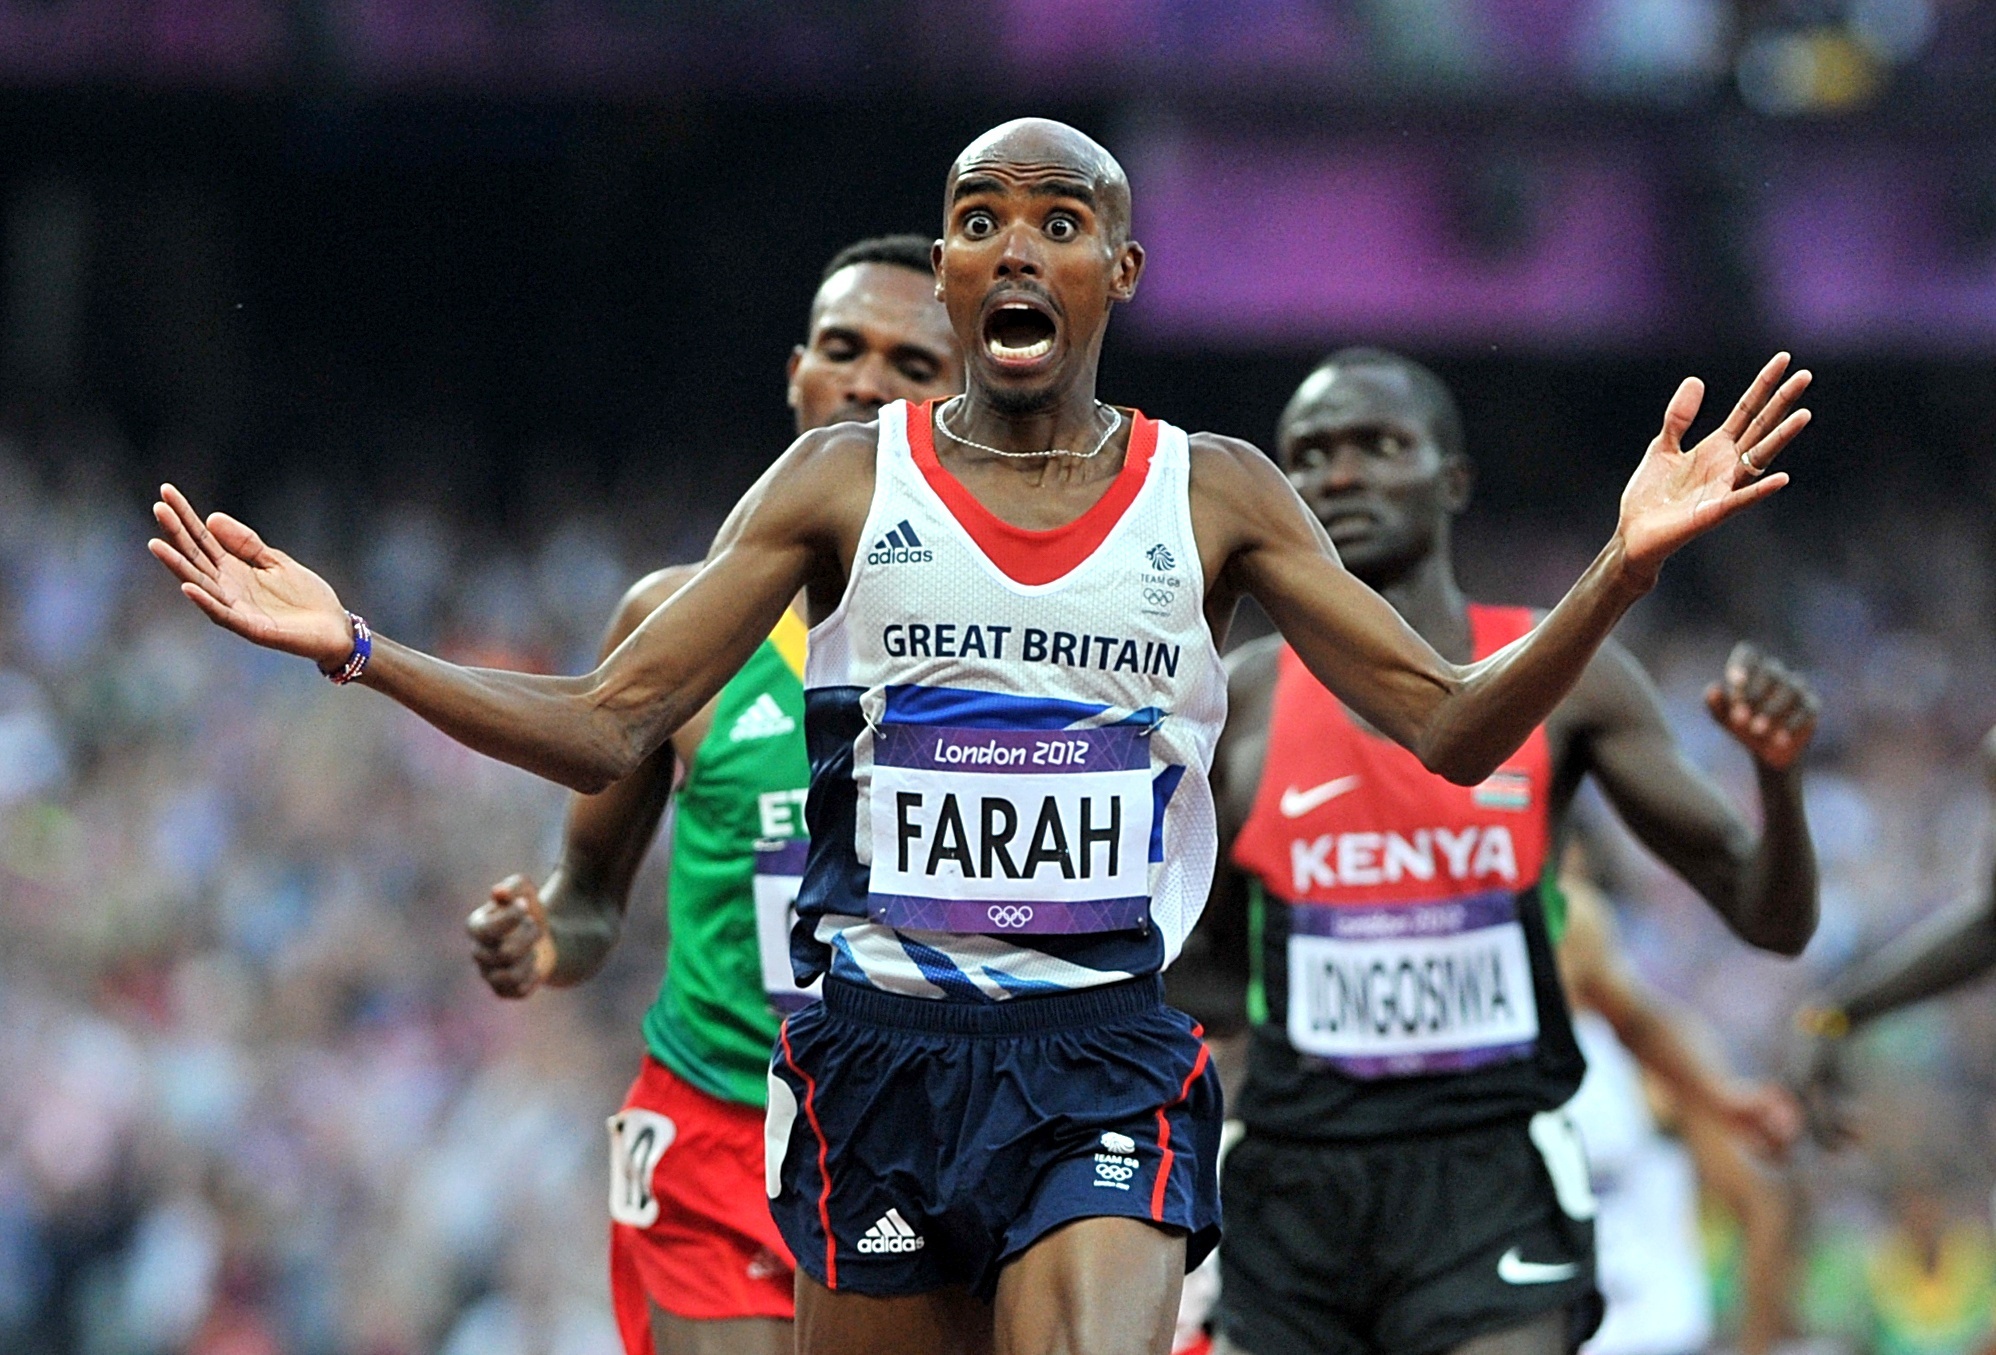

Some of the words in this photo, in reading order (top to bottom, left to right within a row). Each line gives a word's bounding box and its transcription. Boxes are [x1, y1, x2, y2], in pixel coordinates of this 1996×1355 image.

[868, 548, 932, 565] adidas
[1141, 573, 1165, 584] TEAM
[883, 624, 1011, 658] GREAT
[1022, 628, 1180, 677] BRITAIN
[934, 738, 1026, 765] London
[1032, 740, 1089, 765] 2012
[896, 791, 1121, 879] FARAH
[1290, 825, 1518, 893] KENYA
[1094, 1153, 1122, 1164] TEAM
[857, 1235, 924, 1253] adidas
